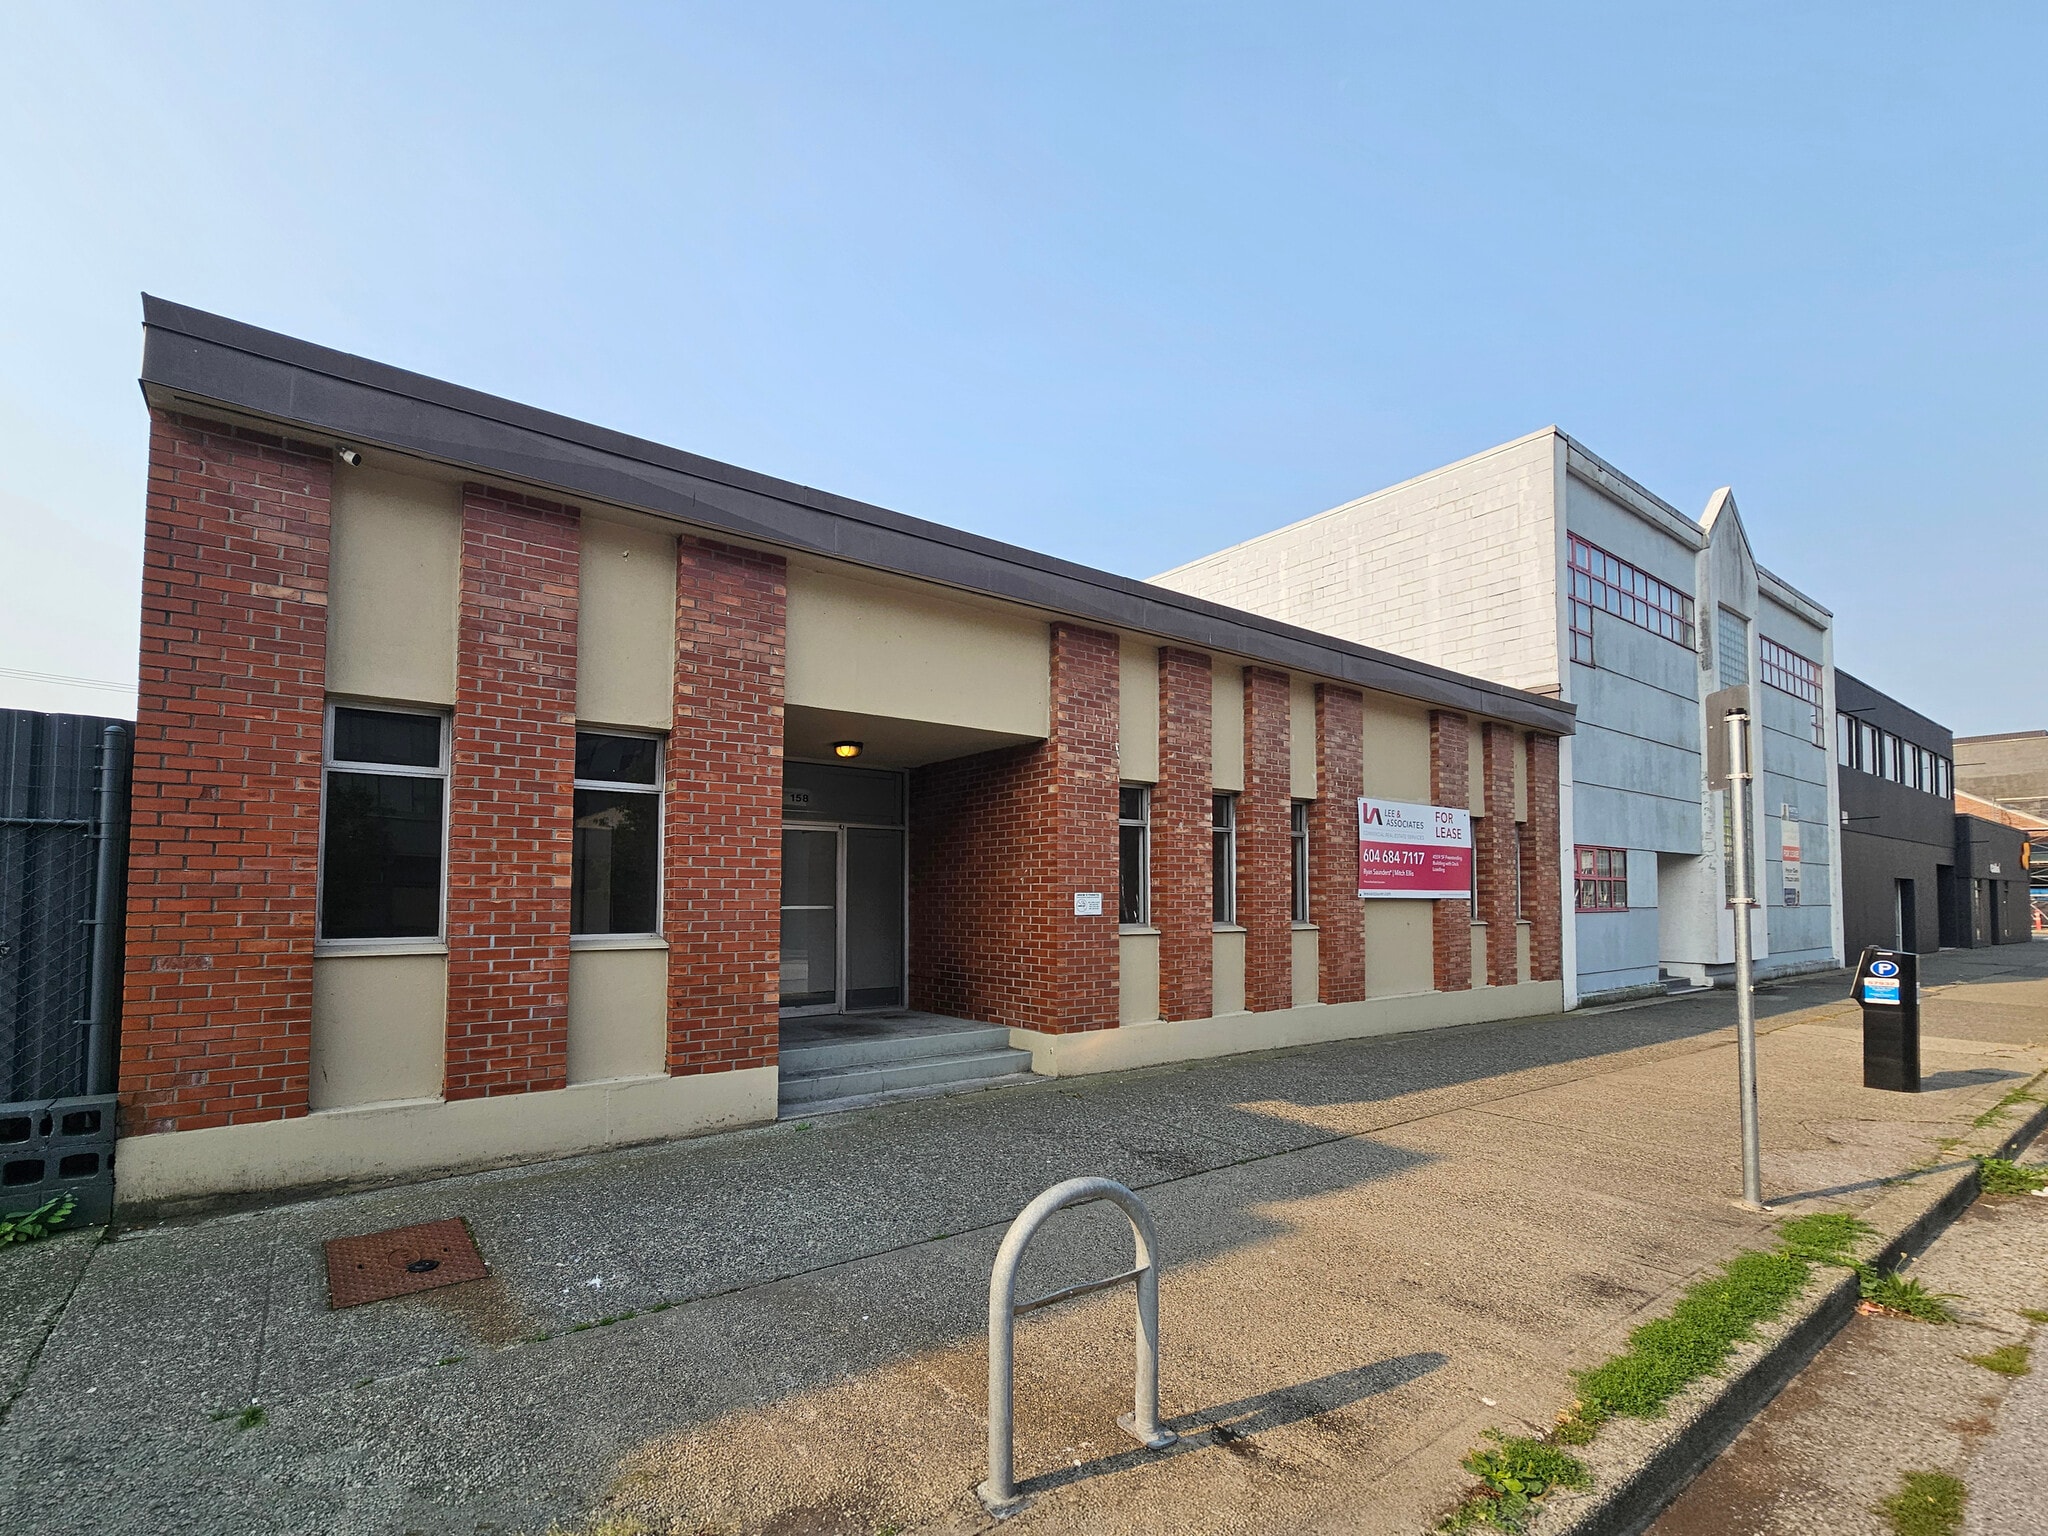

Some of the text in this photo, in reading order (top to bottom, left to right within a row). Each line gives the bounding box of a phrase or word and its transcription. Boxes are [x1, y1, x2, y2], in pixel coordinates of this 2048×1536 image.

[790, 793, 809, 803] 158
[1384, 809, 1401, 819] LEE &
[1435, 811, 1454, 824] FOR
[1386, 819, 1425, 830] ASSOCIATES
[1435, 826, 1462, 840] LEASE
[1363, 848, 1425, 865] 604 684 7117
[1363, 867, 1373, 877] Ryan
[1878, 963, 1893, 975] P
